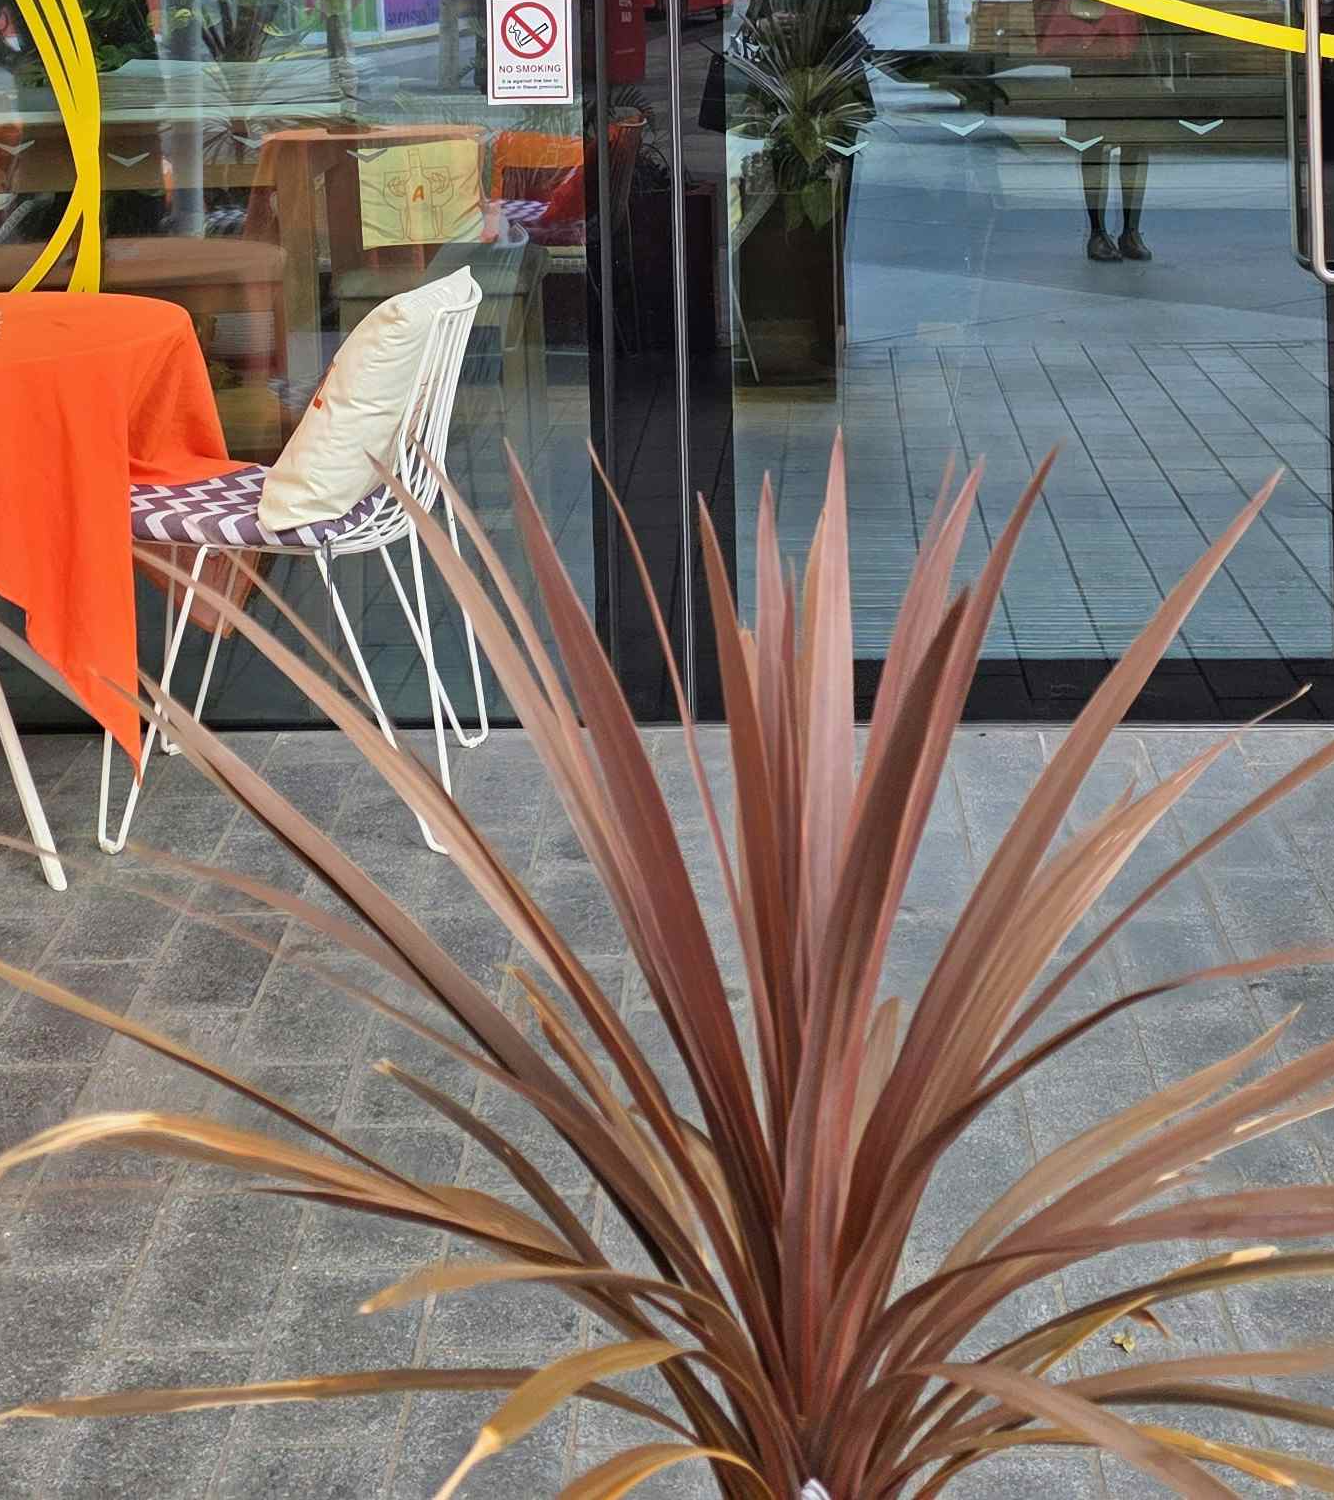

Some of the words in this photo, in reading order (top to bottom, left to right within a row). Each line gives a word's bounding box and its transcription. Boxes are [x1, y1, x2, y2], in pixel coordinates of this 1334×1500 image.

[499, 65, 512, 73] NO
[516, 64, 561, 73] SMOKING
[412, 185, 424, 202] A
